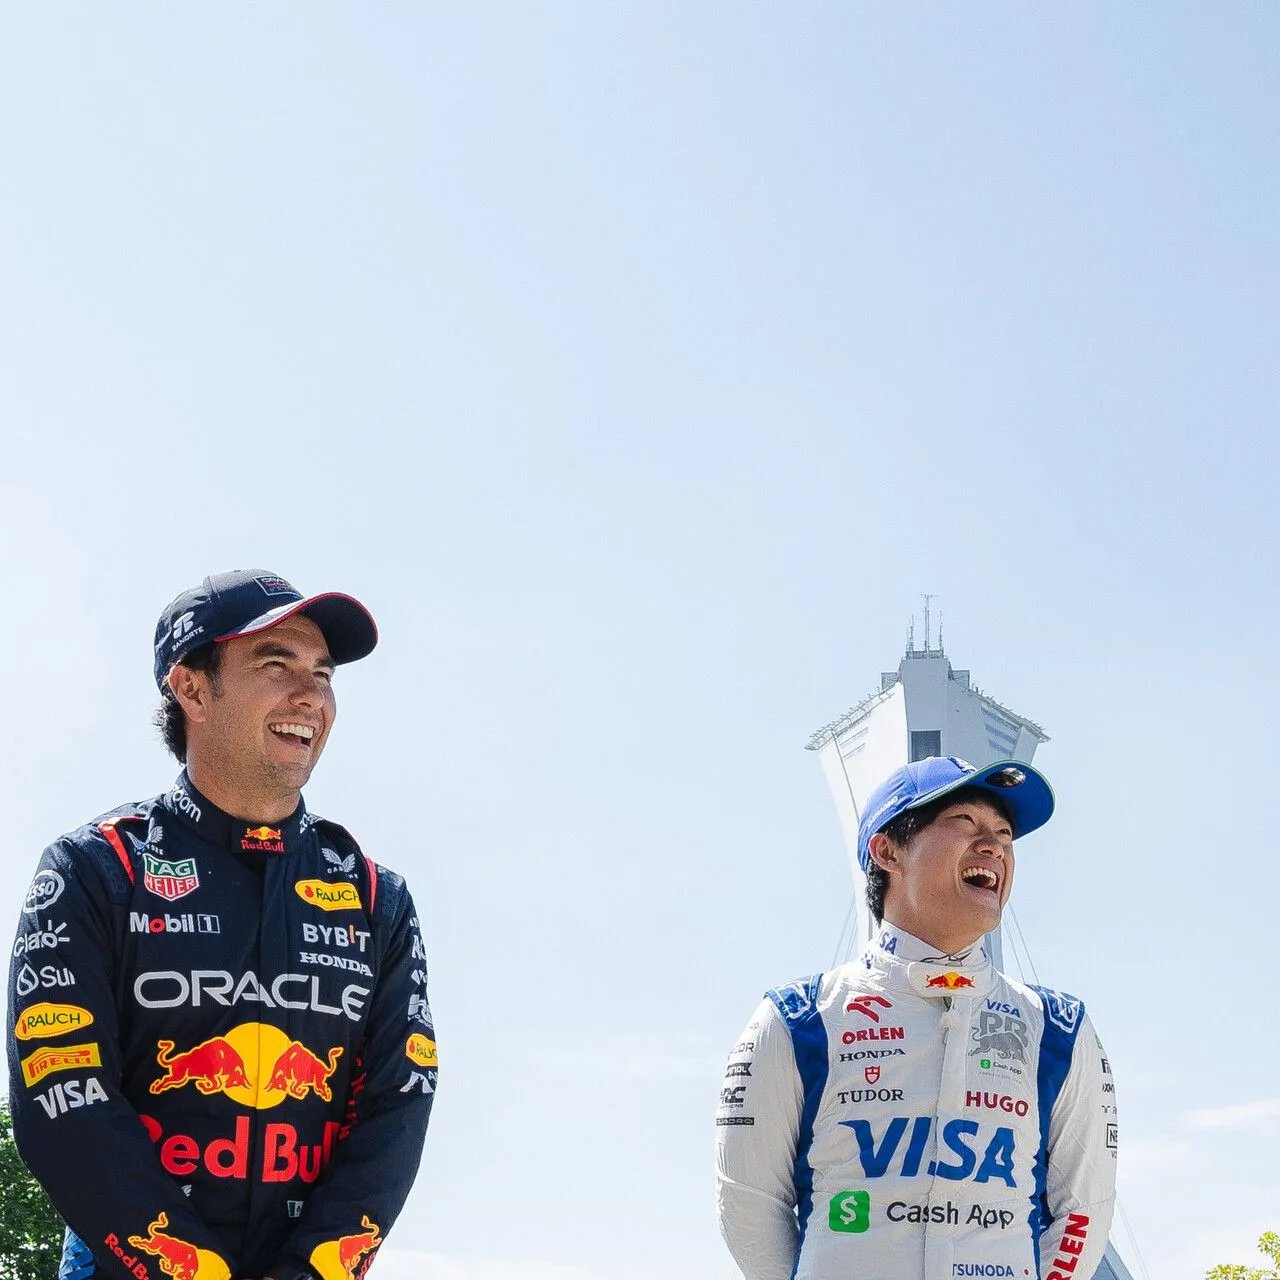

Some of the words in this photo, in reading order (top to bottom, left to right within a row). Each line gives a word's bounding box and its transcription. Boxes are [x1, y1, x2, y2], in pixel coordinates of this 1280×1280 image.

[171, 625, 205, 652] BANORTE
[240, 839, 263, 851] Red
[264, 840, 286, 853] Bull
[146, 856, 192, 877] TAG
[144, 873, 196, 898] HEUER
[129, 911, 195, 934] Mobil
[13, 929, 59, 958] Claro
[302, 922, 371, 953] BYBIT
[298, 950, 373, 976] HONDA
[132, 969, 371, 1022] ORACLE
[985, 997, 1021, 1019] VISA
[26, 1012, 81, 1030] RAUCH
[841, 1026, 905, 1046] ORLEN
[27, 1049, 92, 1079] PIRELLI
[839, 1048, 907, 1063] HONDA
[32, 1077, 110, 1120] VISA
[837, 1088, 905, 1105] TUDOR
[965, 1090, 1030, 1118] HUGO
[837, 1116, 1018, 1188] VISA
[966, 1203, 1015, 1230] App
[104, 1232, 138, 1269] Red
[952, 1263, 1015, 1278] TSUNODA
